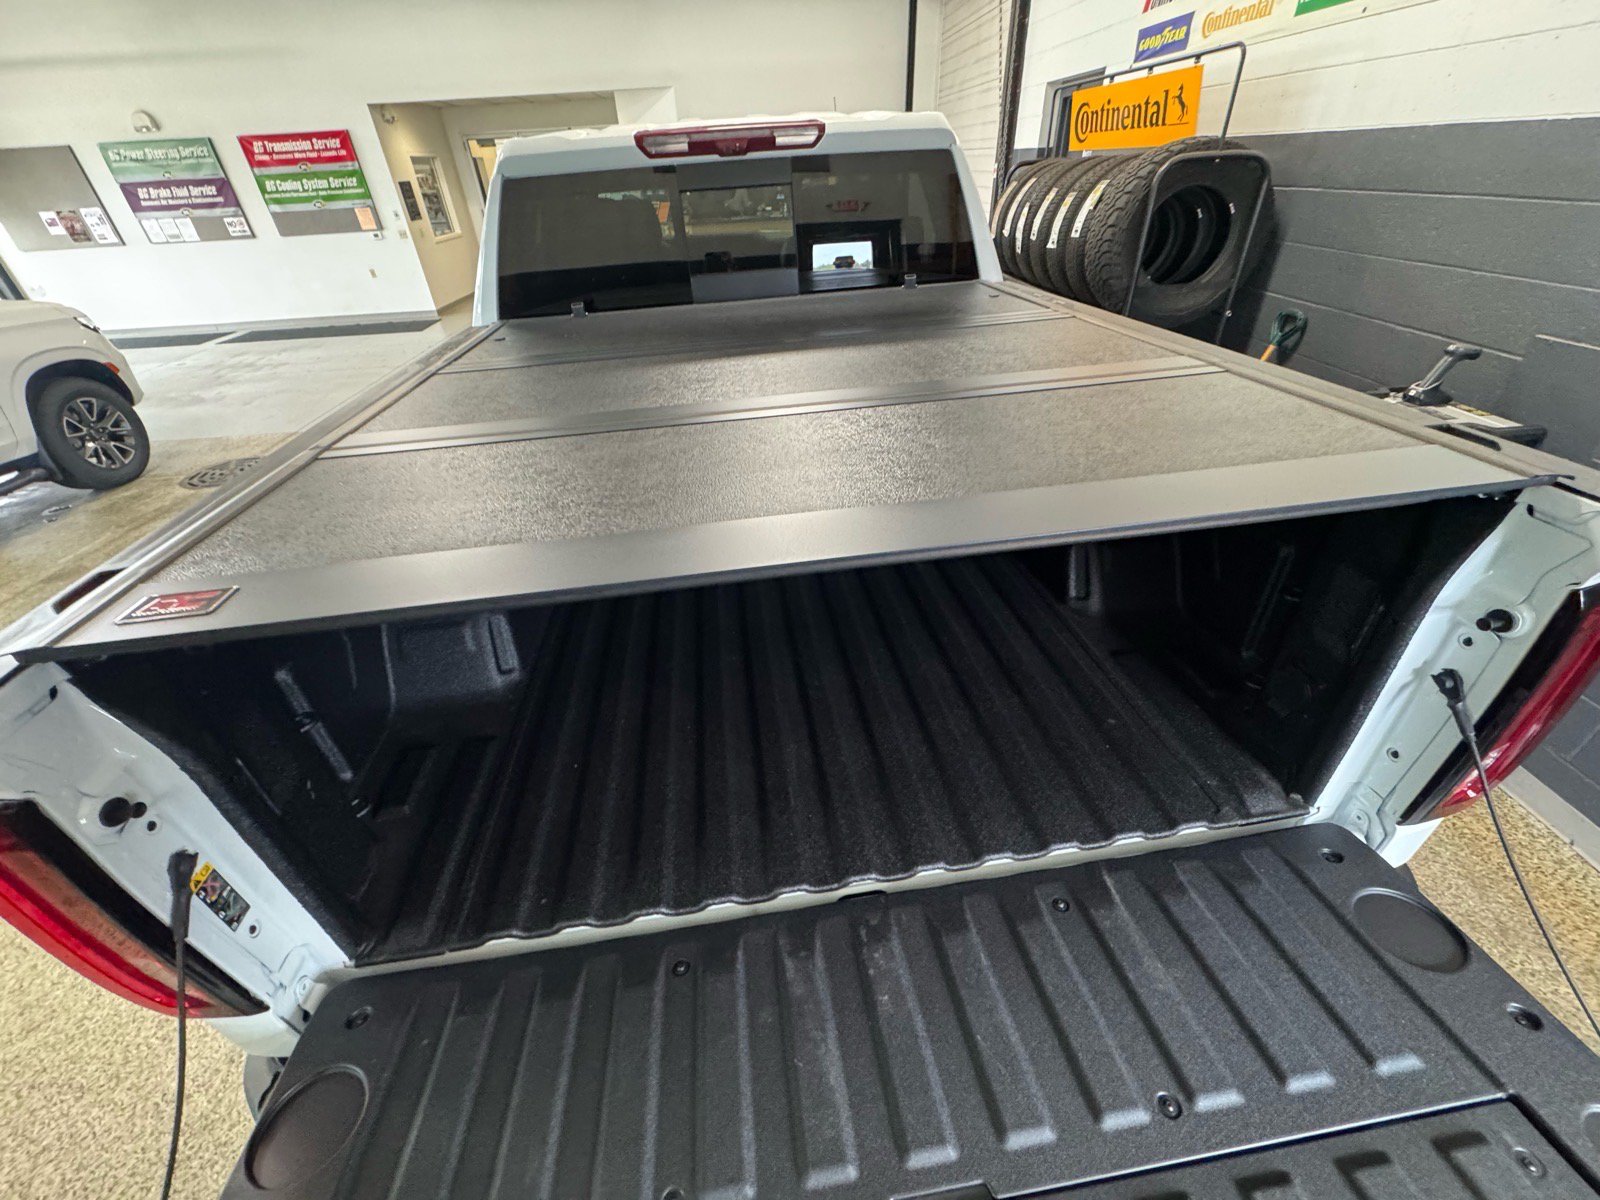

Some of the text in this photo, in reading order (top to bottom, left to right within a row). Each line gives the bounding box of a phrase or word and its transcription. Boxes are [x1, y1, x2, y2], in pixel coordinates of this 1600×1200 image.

[1202, 0, 1274, 39] Continental
[1139, 25, 1187, 51] GOODYEAR
[1075, 89, 1170, 144] Continental
[121, 149, 143, 161] Power
[145, 147, 179, 161] Steering
[179, 145, 209, 158] Service
[265, 138, 312, 153] Transmission
[313, 137, 340, 149] Service
[149, 186, 171, 199] Brake
[172, 185, 190, 198] Fluid
[189, 184, 216, 196] Service
[277, 179, 302, 192] Cooling
[303, 177, 328, 192] System
[329, 176, 357, 188] Service
